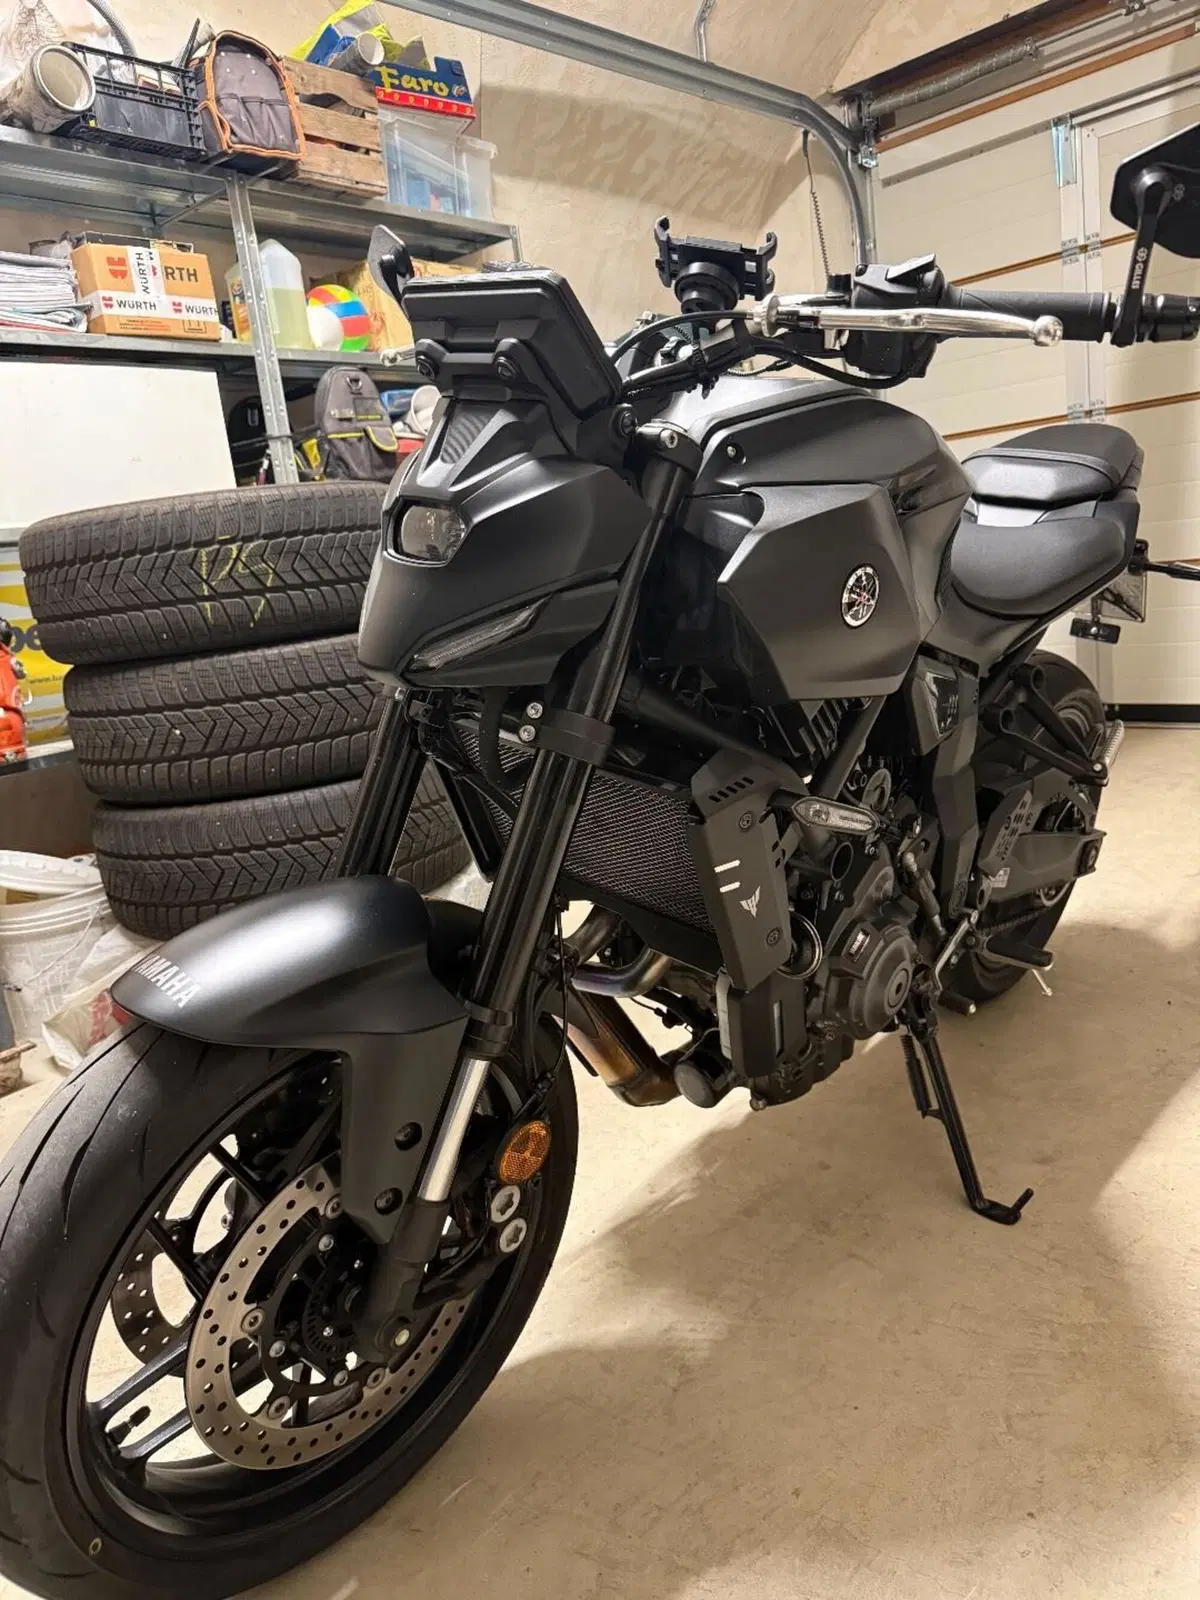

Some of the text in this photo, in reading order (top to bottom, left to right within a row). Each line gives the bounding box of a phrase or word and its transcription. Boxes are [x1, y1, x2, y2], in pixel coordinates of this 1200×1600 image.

[374, 65, 449, 97] Faro
[164, 265, 199, 283] RTH
[116, 299, 157, 311] WÜRTH
